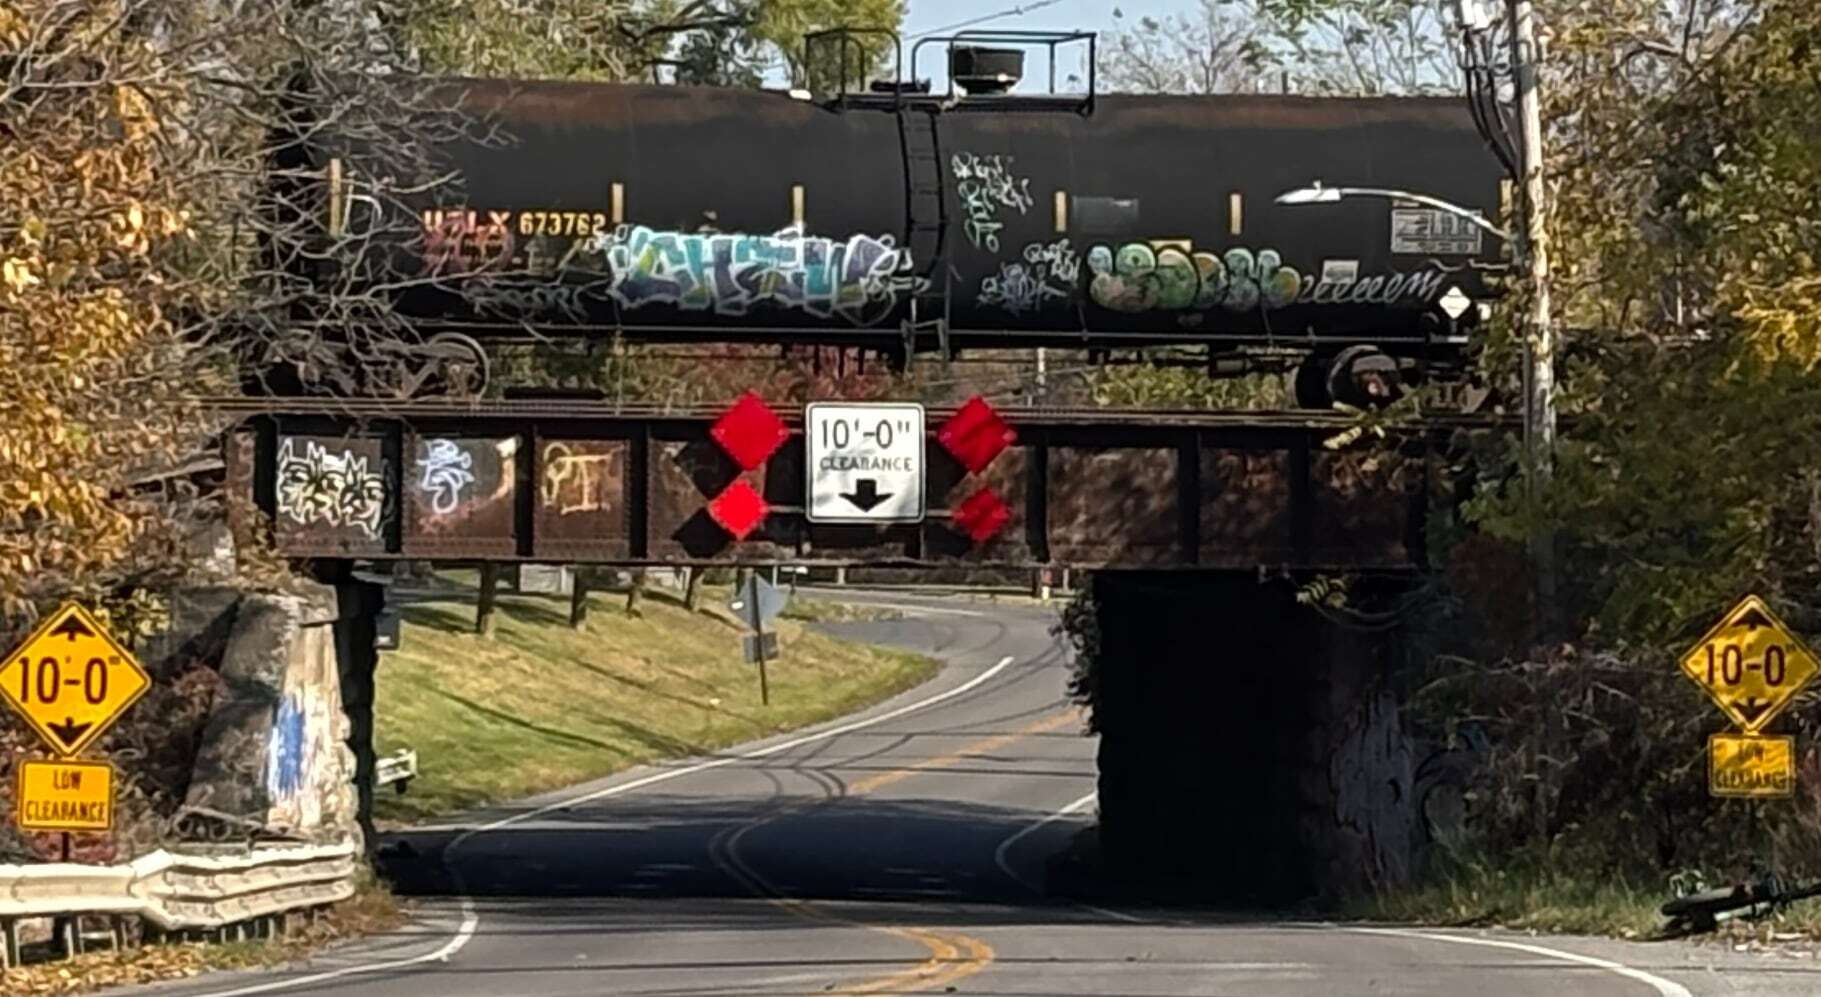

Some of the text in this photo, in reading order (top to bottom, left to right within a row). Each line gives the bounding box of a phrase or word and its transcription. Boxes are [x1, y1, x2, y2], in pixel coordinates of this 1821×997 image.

[821, 418, 911, 450] 10'-0"
[819, 456, 913, 472] CLEARANCE
[52, 769, 82, 791] LOW
[26, 800, 106, 822] CLEARANCE
